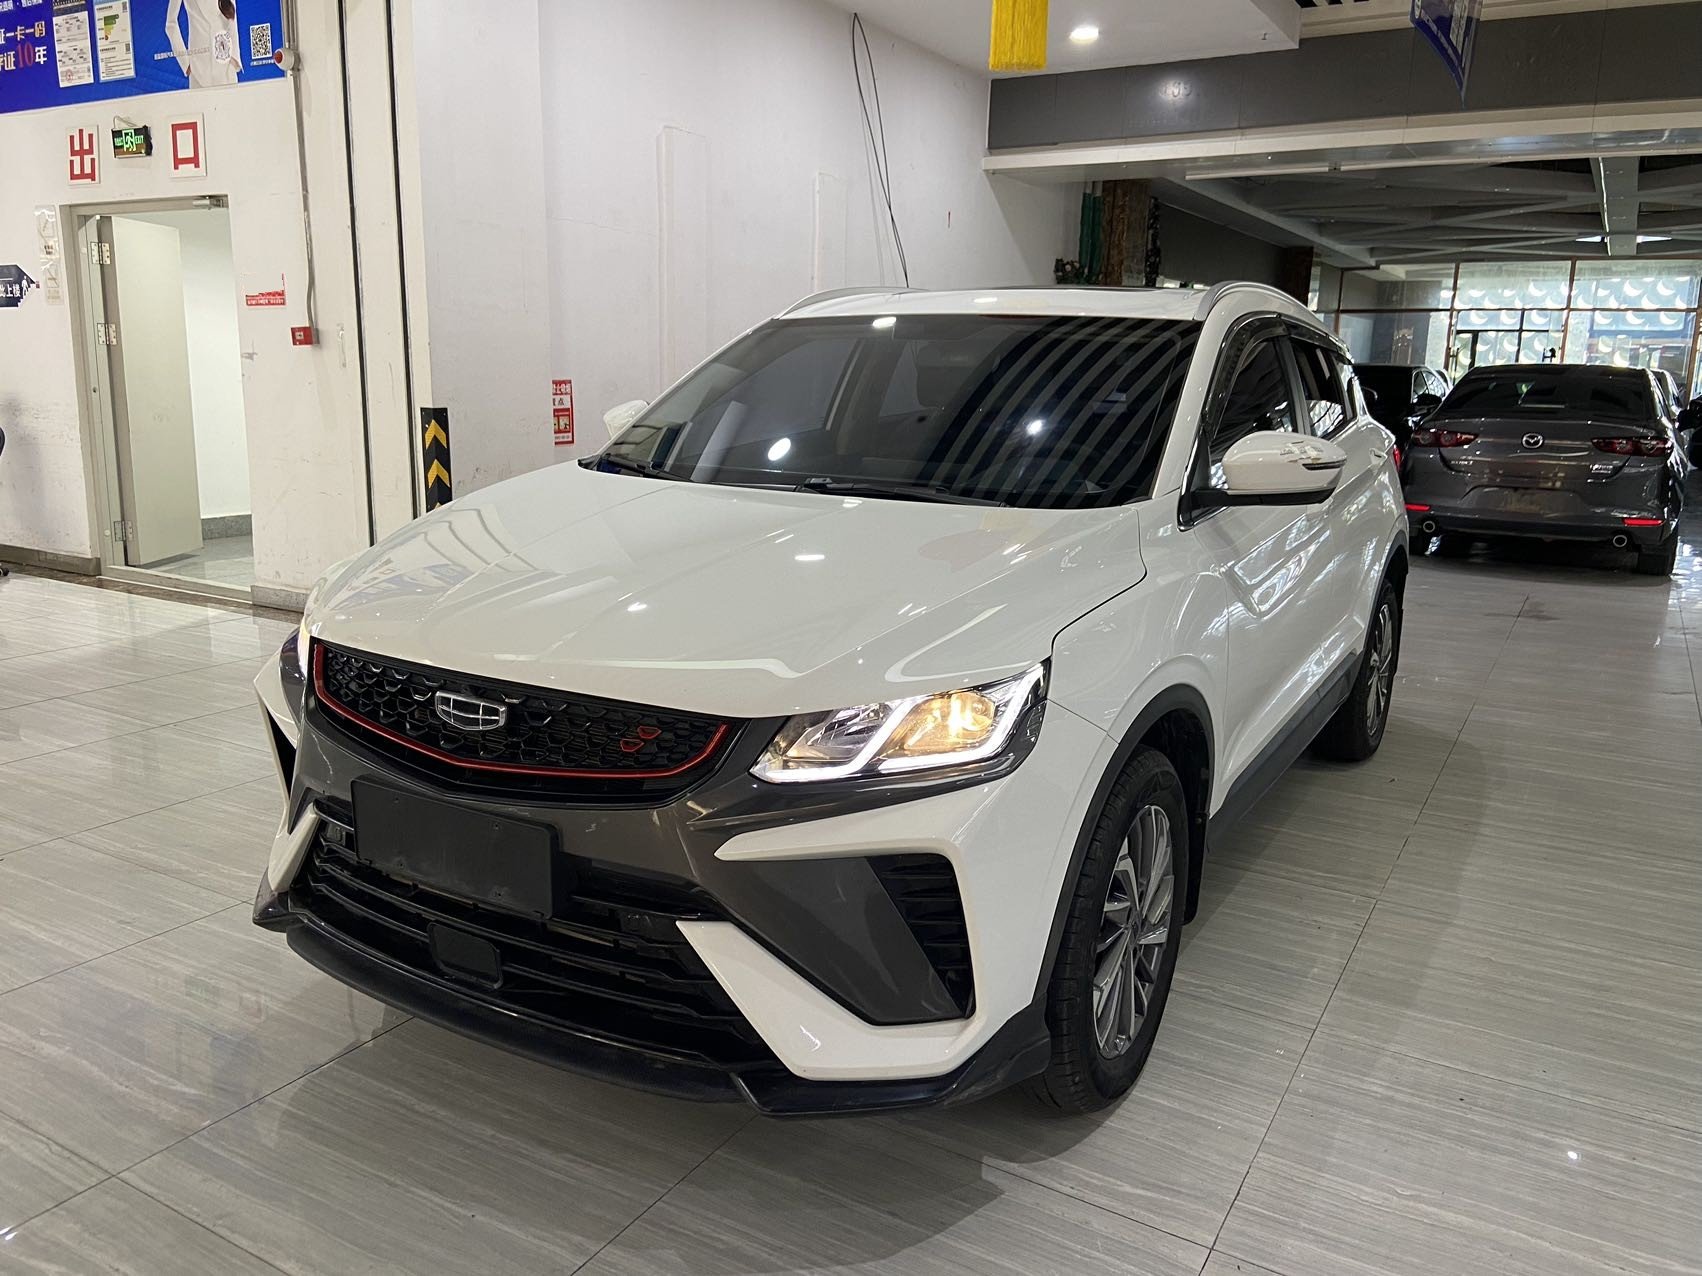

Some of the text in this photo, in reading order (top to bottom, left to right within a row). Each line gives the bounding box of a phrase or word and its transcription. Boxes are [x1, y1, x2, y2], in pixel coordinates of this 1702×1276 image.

[69, 121, 200, 182] 出 口
[134, 135, 144, 144] EXIT
